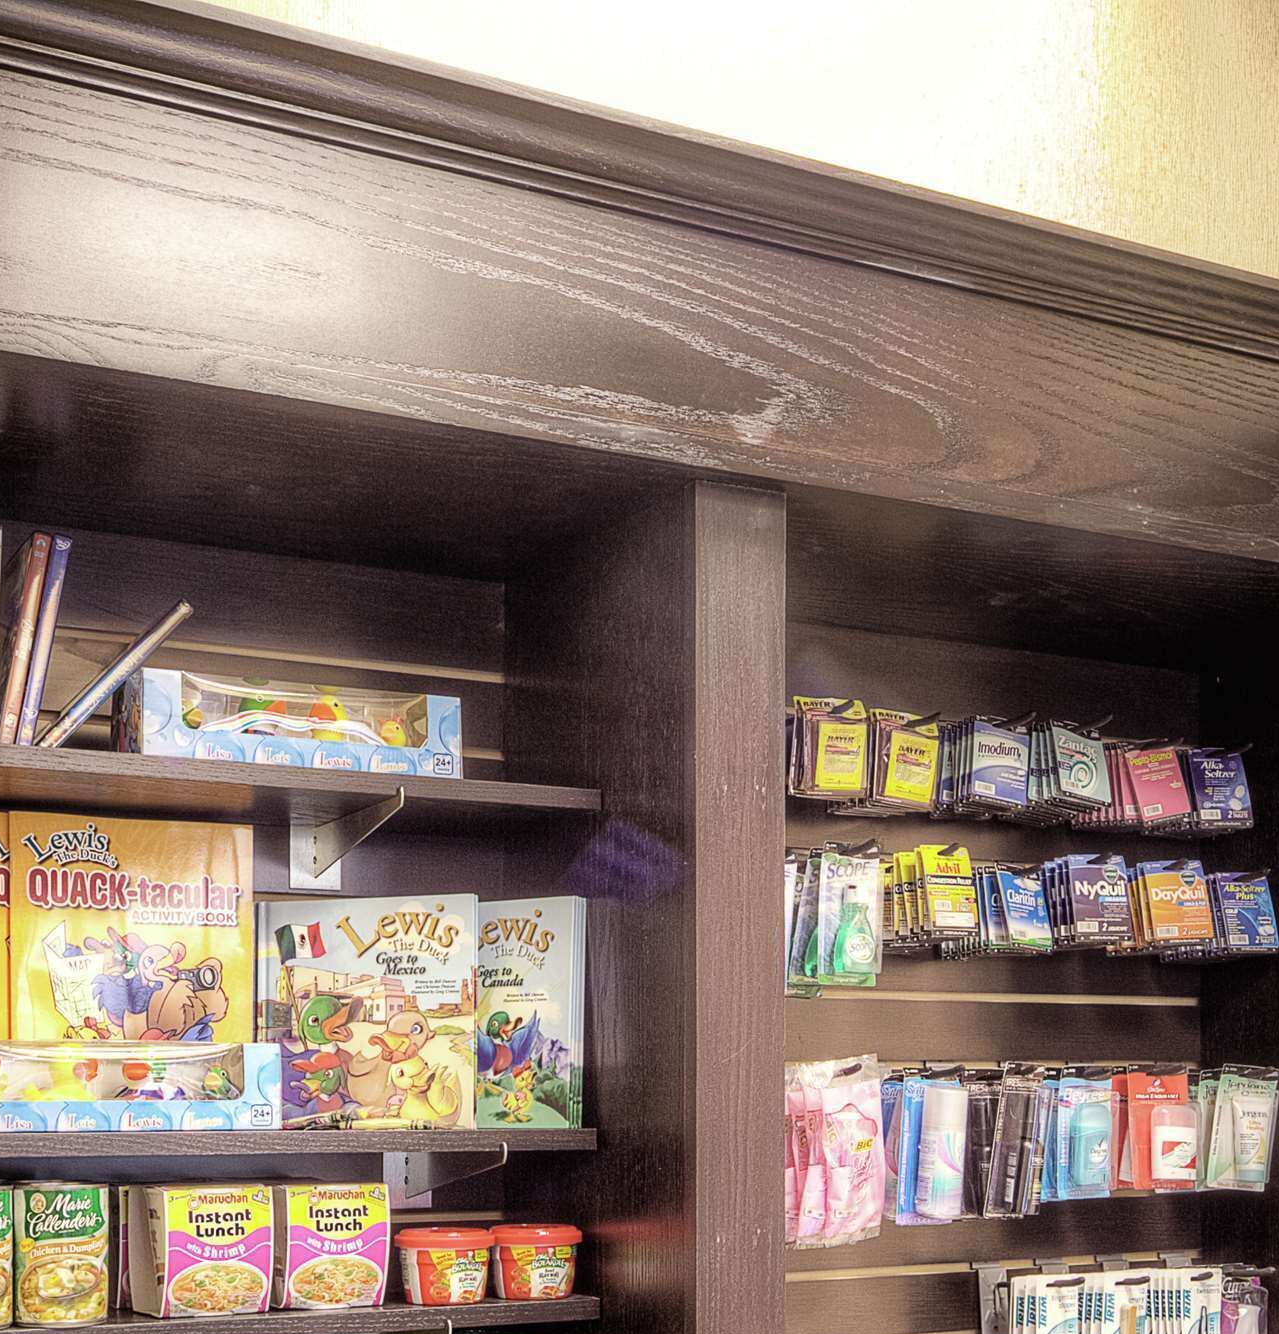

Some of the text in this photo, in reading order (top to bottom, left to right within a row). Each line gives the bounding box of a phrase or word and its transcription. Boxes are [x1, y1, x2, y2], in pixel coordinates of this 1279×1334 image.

[803, 699, 832, 708] BAYER
[878, 711, 905, 721] BAYER
[827, 735, 855, 744] BAYER
[1058, 735, 1098, 756] Zantac
[898, 745, 926, 756] BAYER
[978, 740, 1020, 757] Imodium
[435, 758, 451, 767] 24+
[1200, 761, 1224, 770] Alka-
[1204, 769, 1237, 779] Seltzer
[22, 824, 110, 862] Lewis
[54, 848, 118, 868] The Duck's
[826, 861, 870, 880] SCOPE
[935, 862, 961, 874] Advil
[27, 867, 241, 911] QUACK-tacular
[1075, 880, 1126, 900] NyQuil
[1151, 886, 1205, 904] DayQuil
[1236, 892, 1254, 901] Plus
[1007, 889, 1036, 907] Claritin
[131, 909, 235, 924] ACTIVITY BOOK
[336, 903, 459, 958] Lewis
[1102, 923, 1107, 932] 2
[375, 951, 419, 966] Goes to
[388, 939, 449, 965] The Duck
[491, 946, 545, 970] The Duck
[384, 964, 426, 976] Mexico
[477, 965, 512, 978] Goes to
[482, 974, 524, 988] Canada
[252, 1108, 270, 1119] 24+
[856, 1138, 873, 1151] BIC
[198, 1193, 248, 1204] Maruchan
[318, 1189, 366, 1200] Maruchan
[46, 1193, 92, 1212] Marie
[188, 1208, 252, 1224] Instant
[308, 1204, 369, 1219] Instant
[28, 1212, 101, 1239] Callender's
[196, 1224, 245, 1238] Lunch
[316, 1218, 363, 1232] Lunch
[203, 1243, 246, 1258] Shrimp
[321, 1237, 363, 1253] Shrimp
[30, 1247, 61, 1259] Chicken
[1104, 1292, 1115, 1324] TRIM
[1183, 1289, 1192, 1319] TRIM
[1038, 1296, 1047, 1328] TRIM
